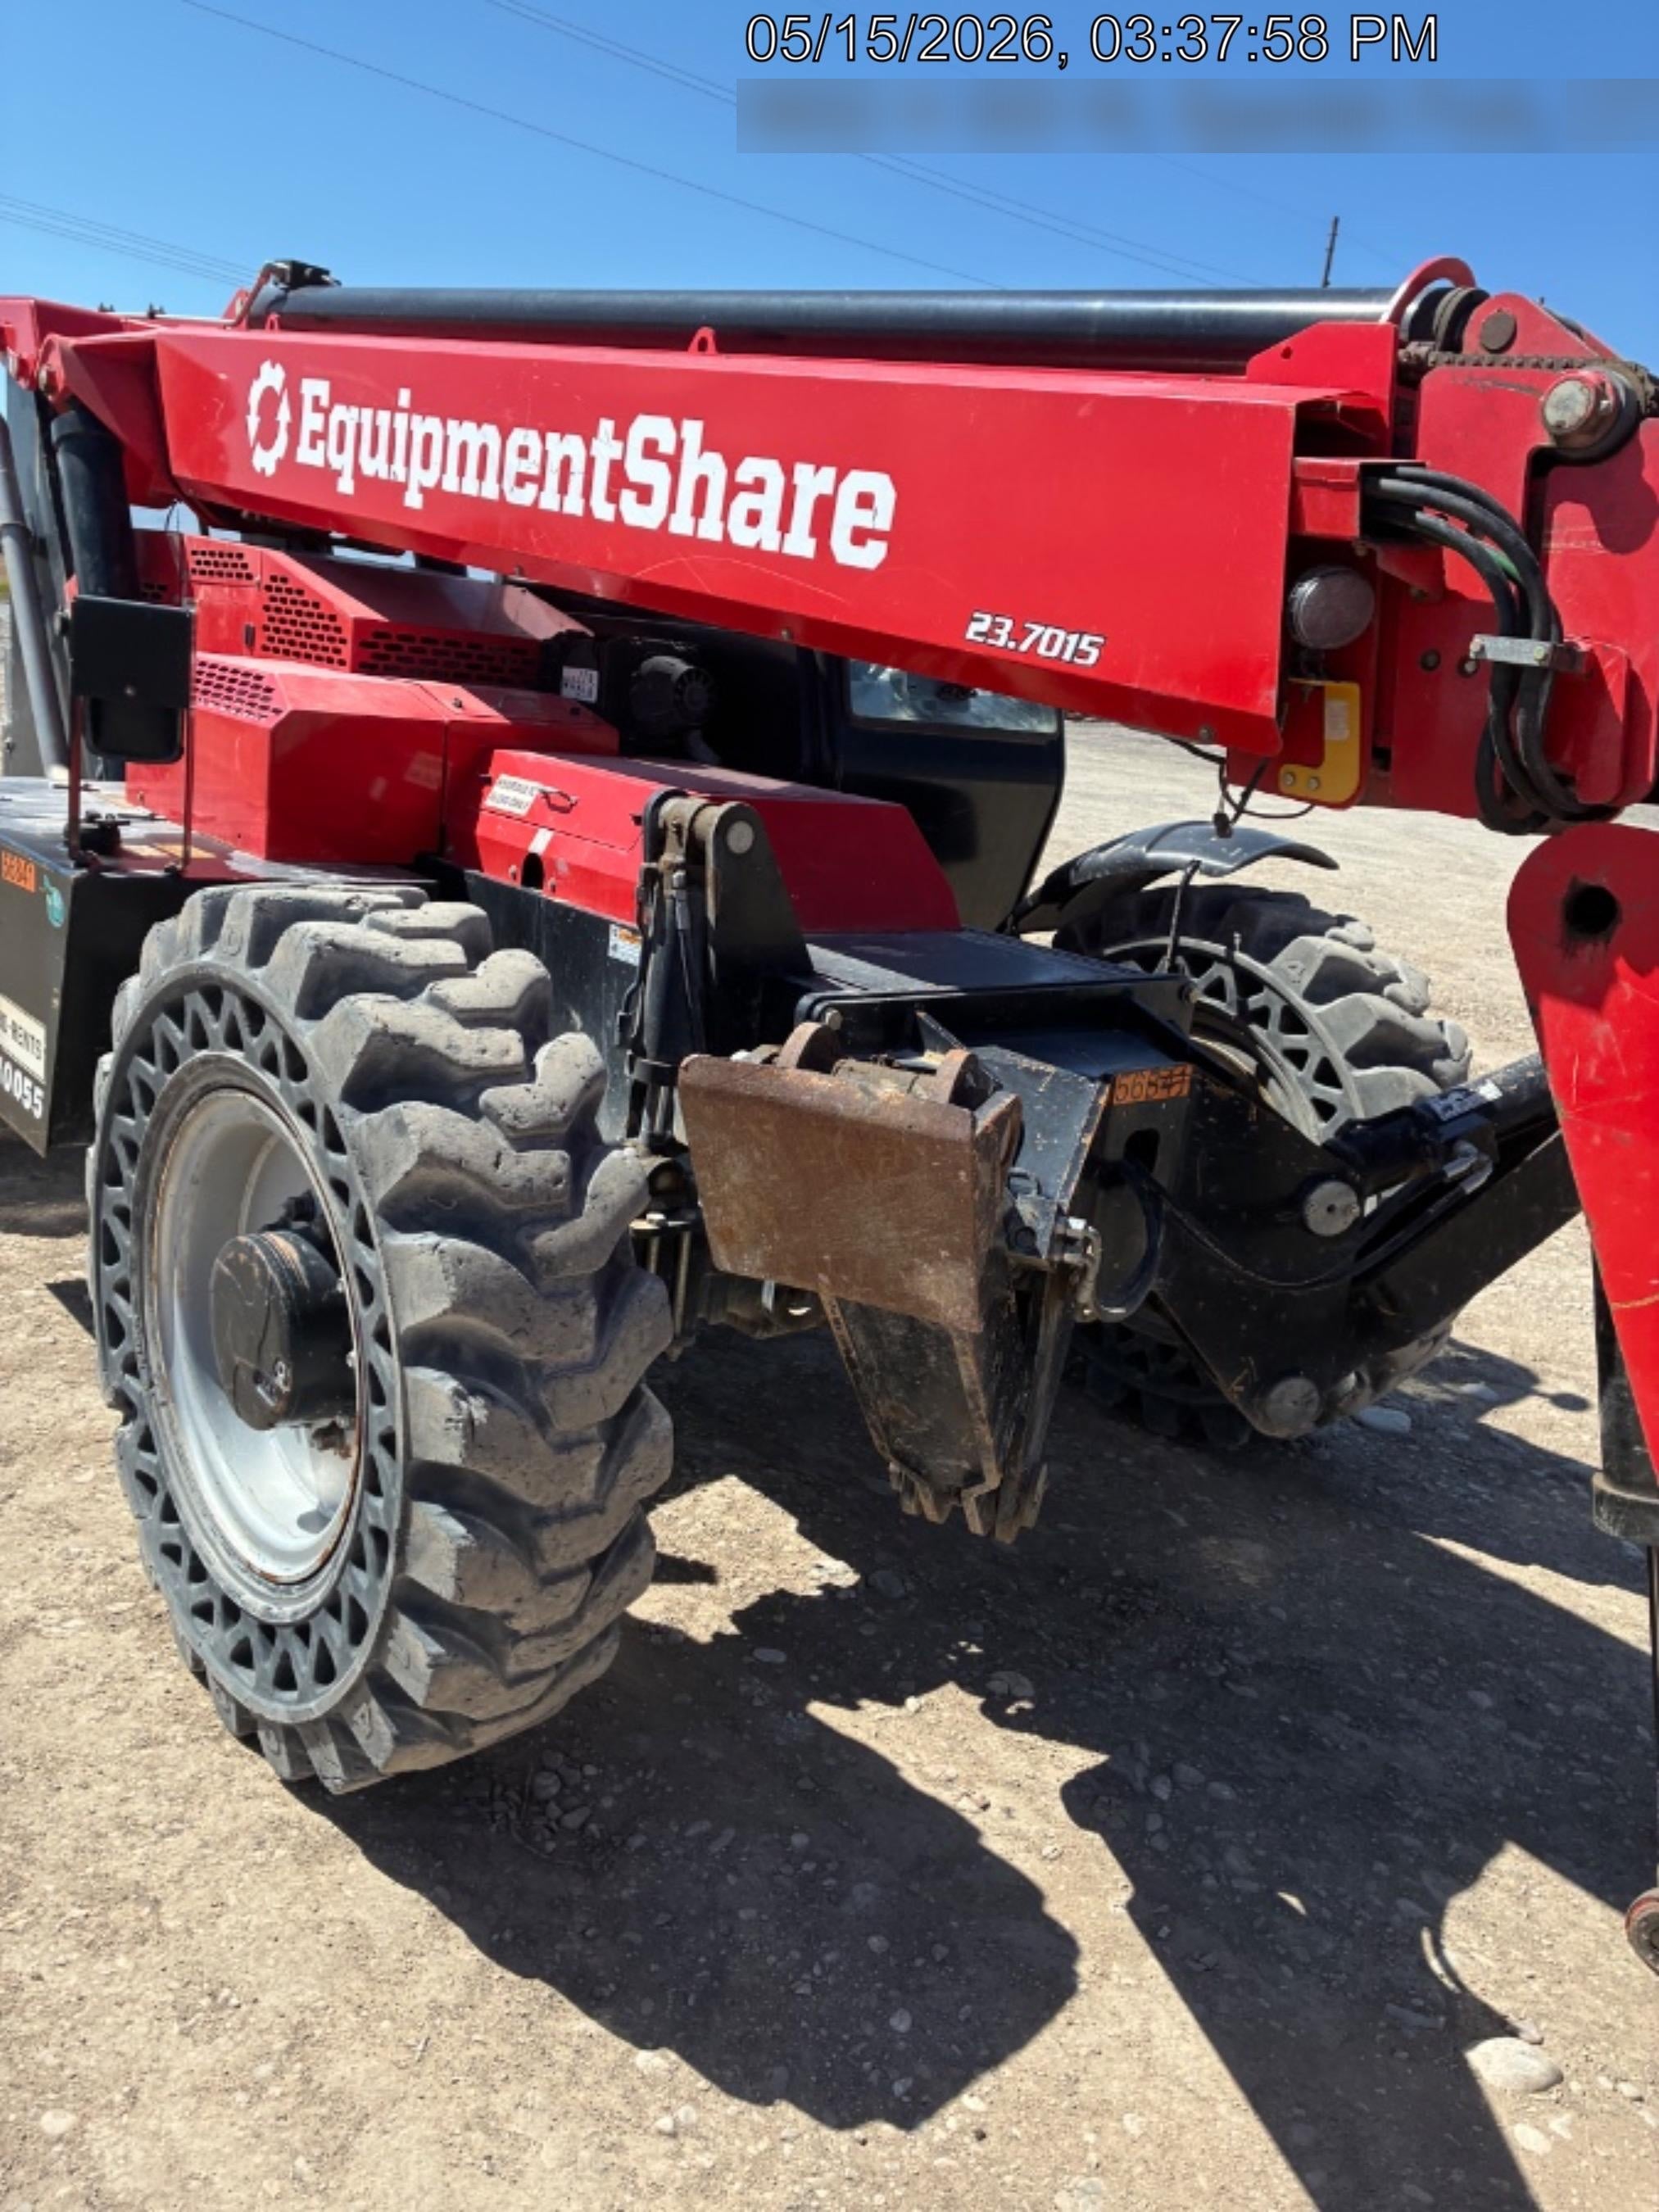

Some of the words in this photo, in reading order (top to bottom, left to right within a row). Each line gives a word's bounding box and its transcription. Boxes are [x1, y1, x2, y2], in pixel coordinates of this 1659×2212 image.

[296, 377, 896, 570] EquipmentShare
[965, 610, 1106, 667] 23.7015
[0, 1055, 44, 1119] 0055
